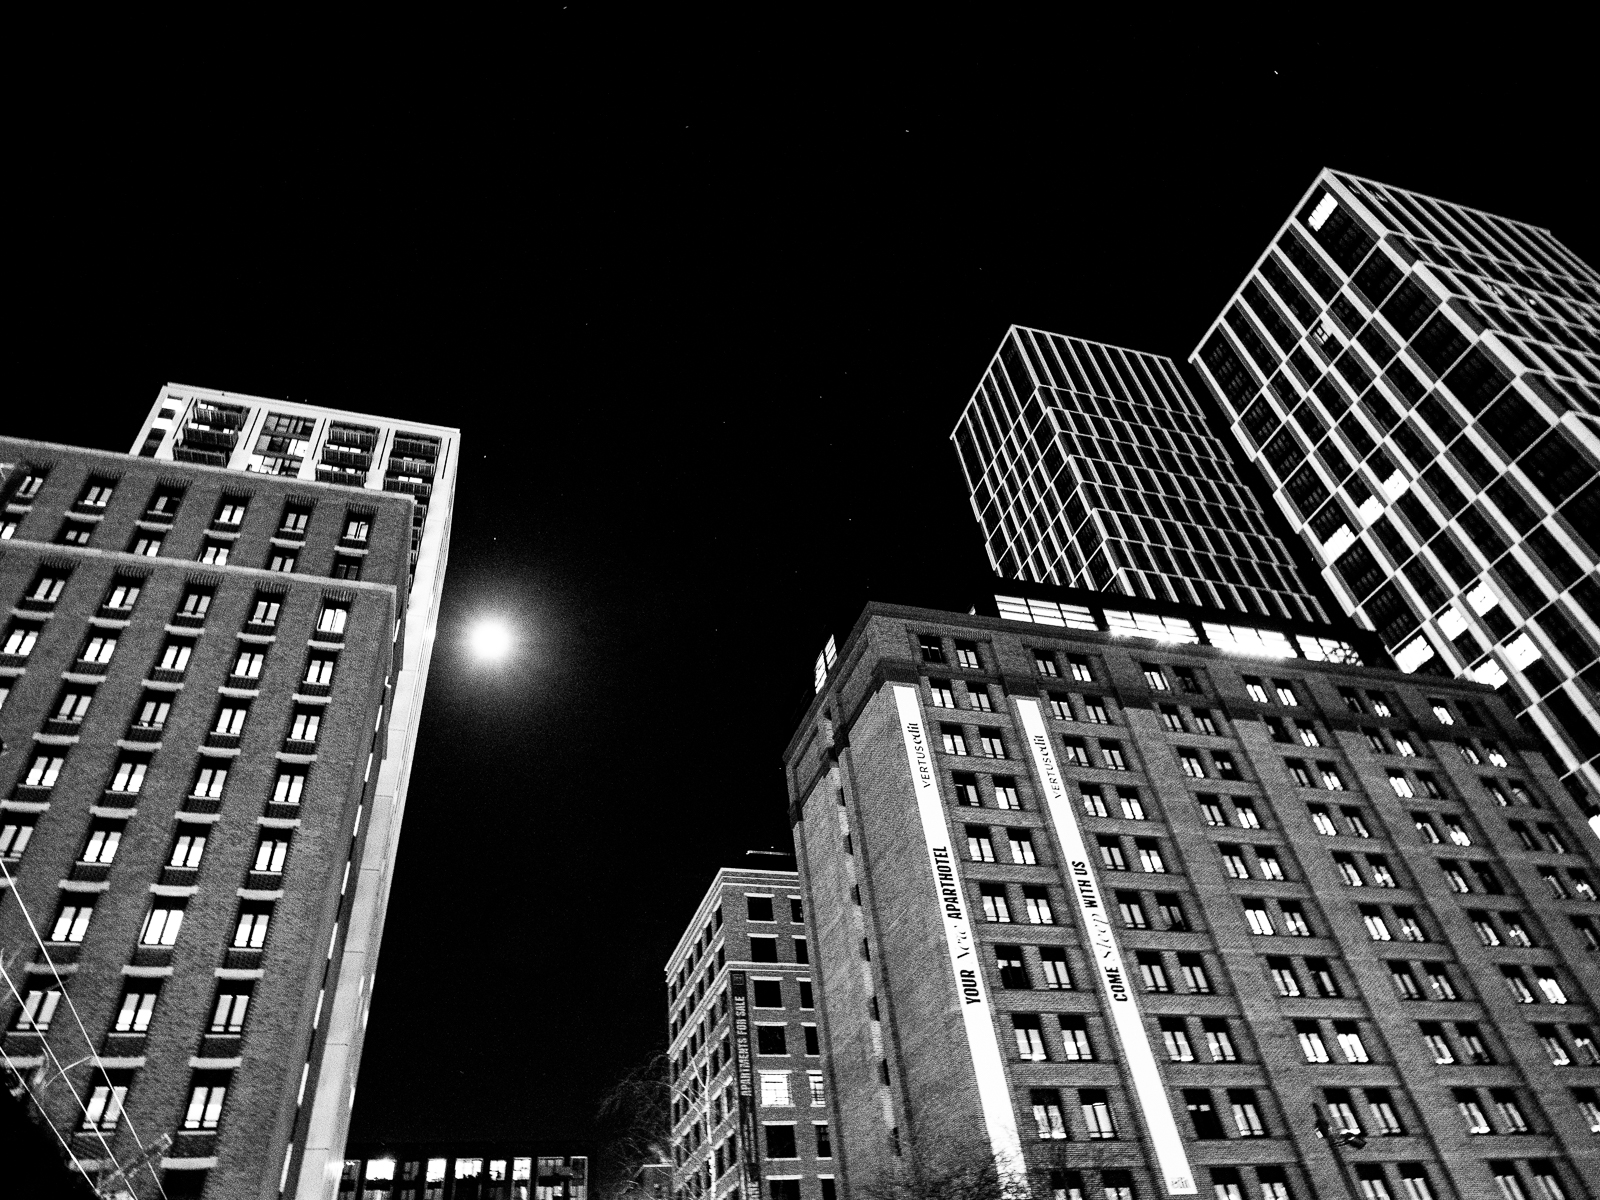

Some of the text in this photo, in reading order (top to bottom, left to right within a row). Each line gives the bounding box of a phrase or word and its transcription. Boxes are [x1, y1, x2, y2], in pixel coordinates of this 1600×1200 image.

[932, 846, 963, 920] APARTHOTEL
[1071, 860, 1088, 876] US
[1077, 879, 1099, 908] WITH
[960, 969, 981, 1005] YOUR
[1104, 966, 1128, 1002] COME
[735, 996, 752, 1097] APARTMENTS FOR SALE
